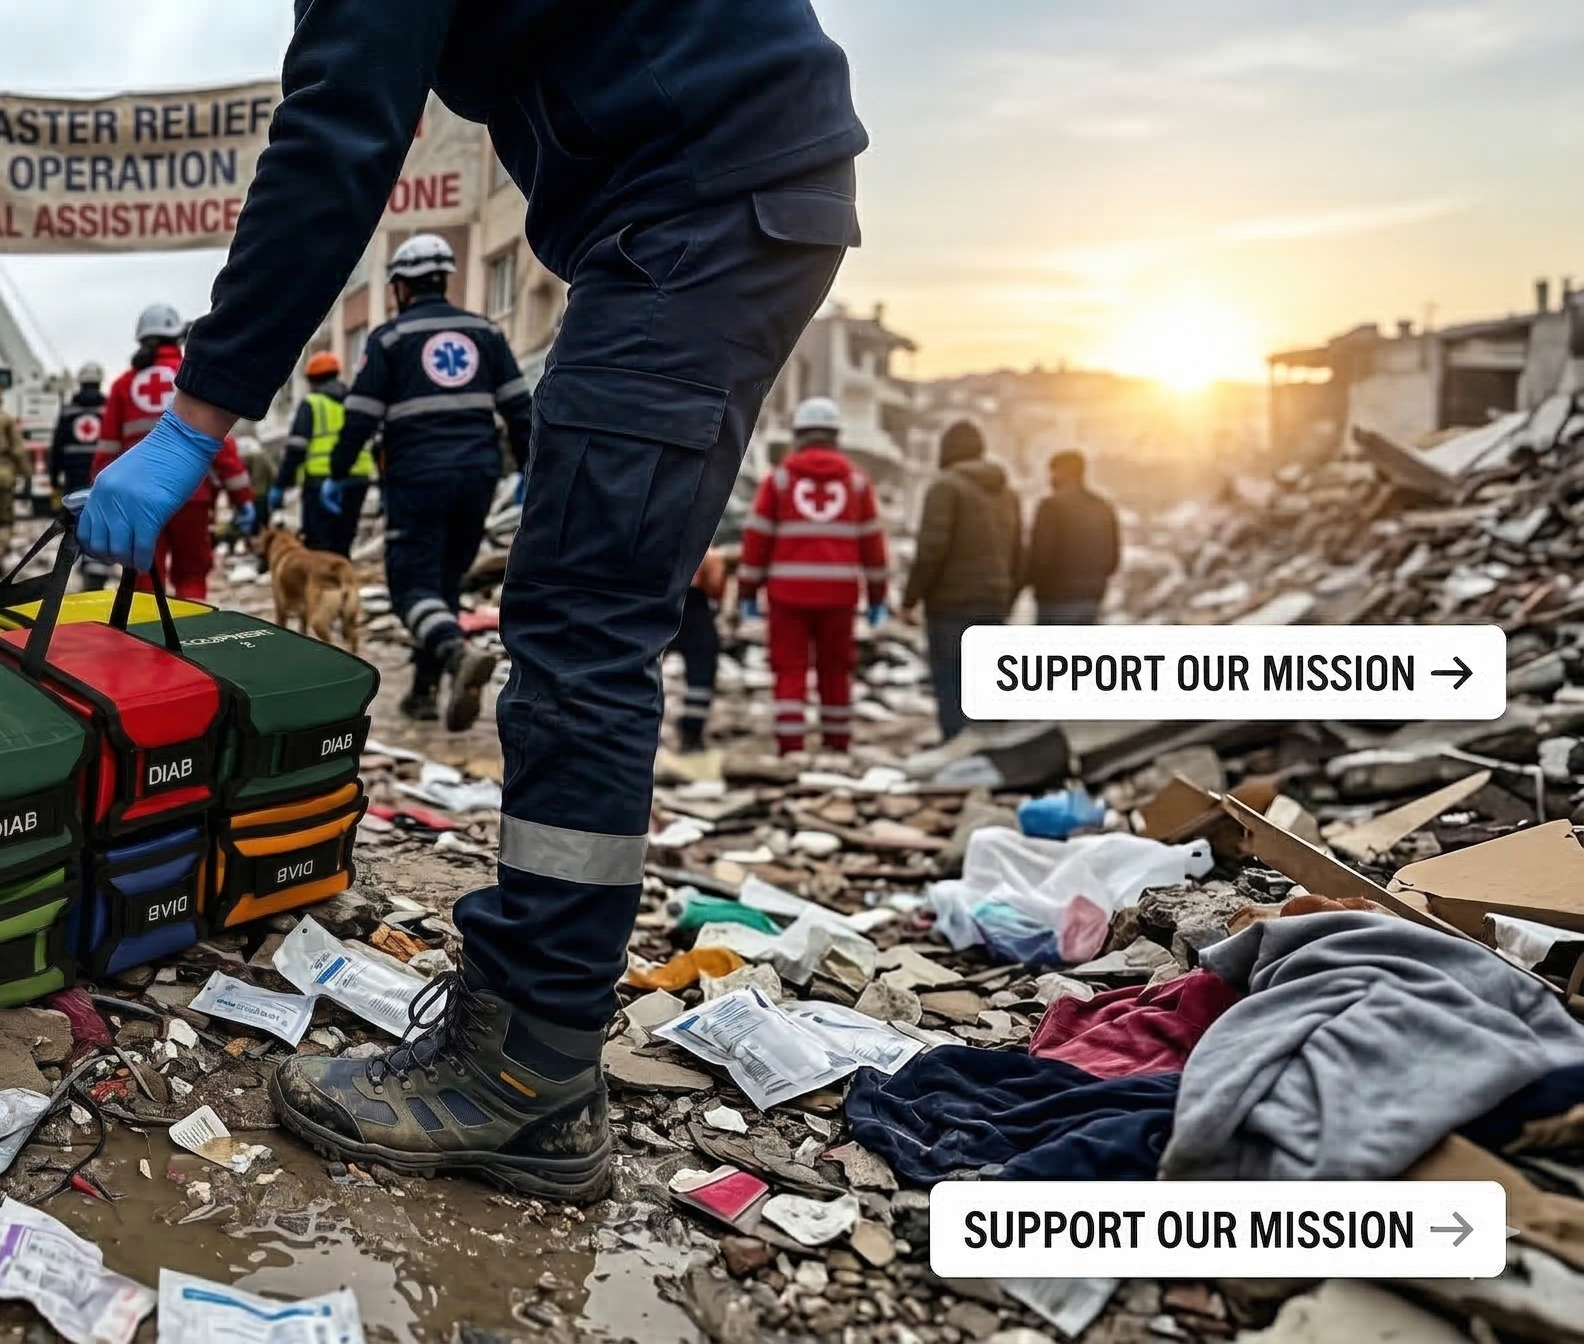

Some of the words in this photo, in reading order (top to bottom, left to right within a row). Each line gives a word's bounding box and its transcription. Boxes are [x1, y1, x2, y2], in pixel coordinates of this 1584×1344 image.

[134, 98, 272, 143] RELIEF
[9, 150, 236, 191] OPERATION
[33, 198, 242, 237] ASSISTANCE
[322, 733, 352, 756] DIAB
[148, 758, 193, 786] DIAB
